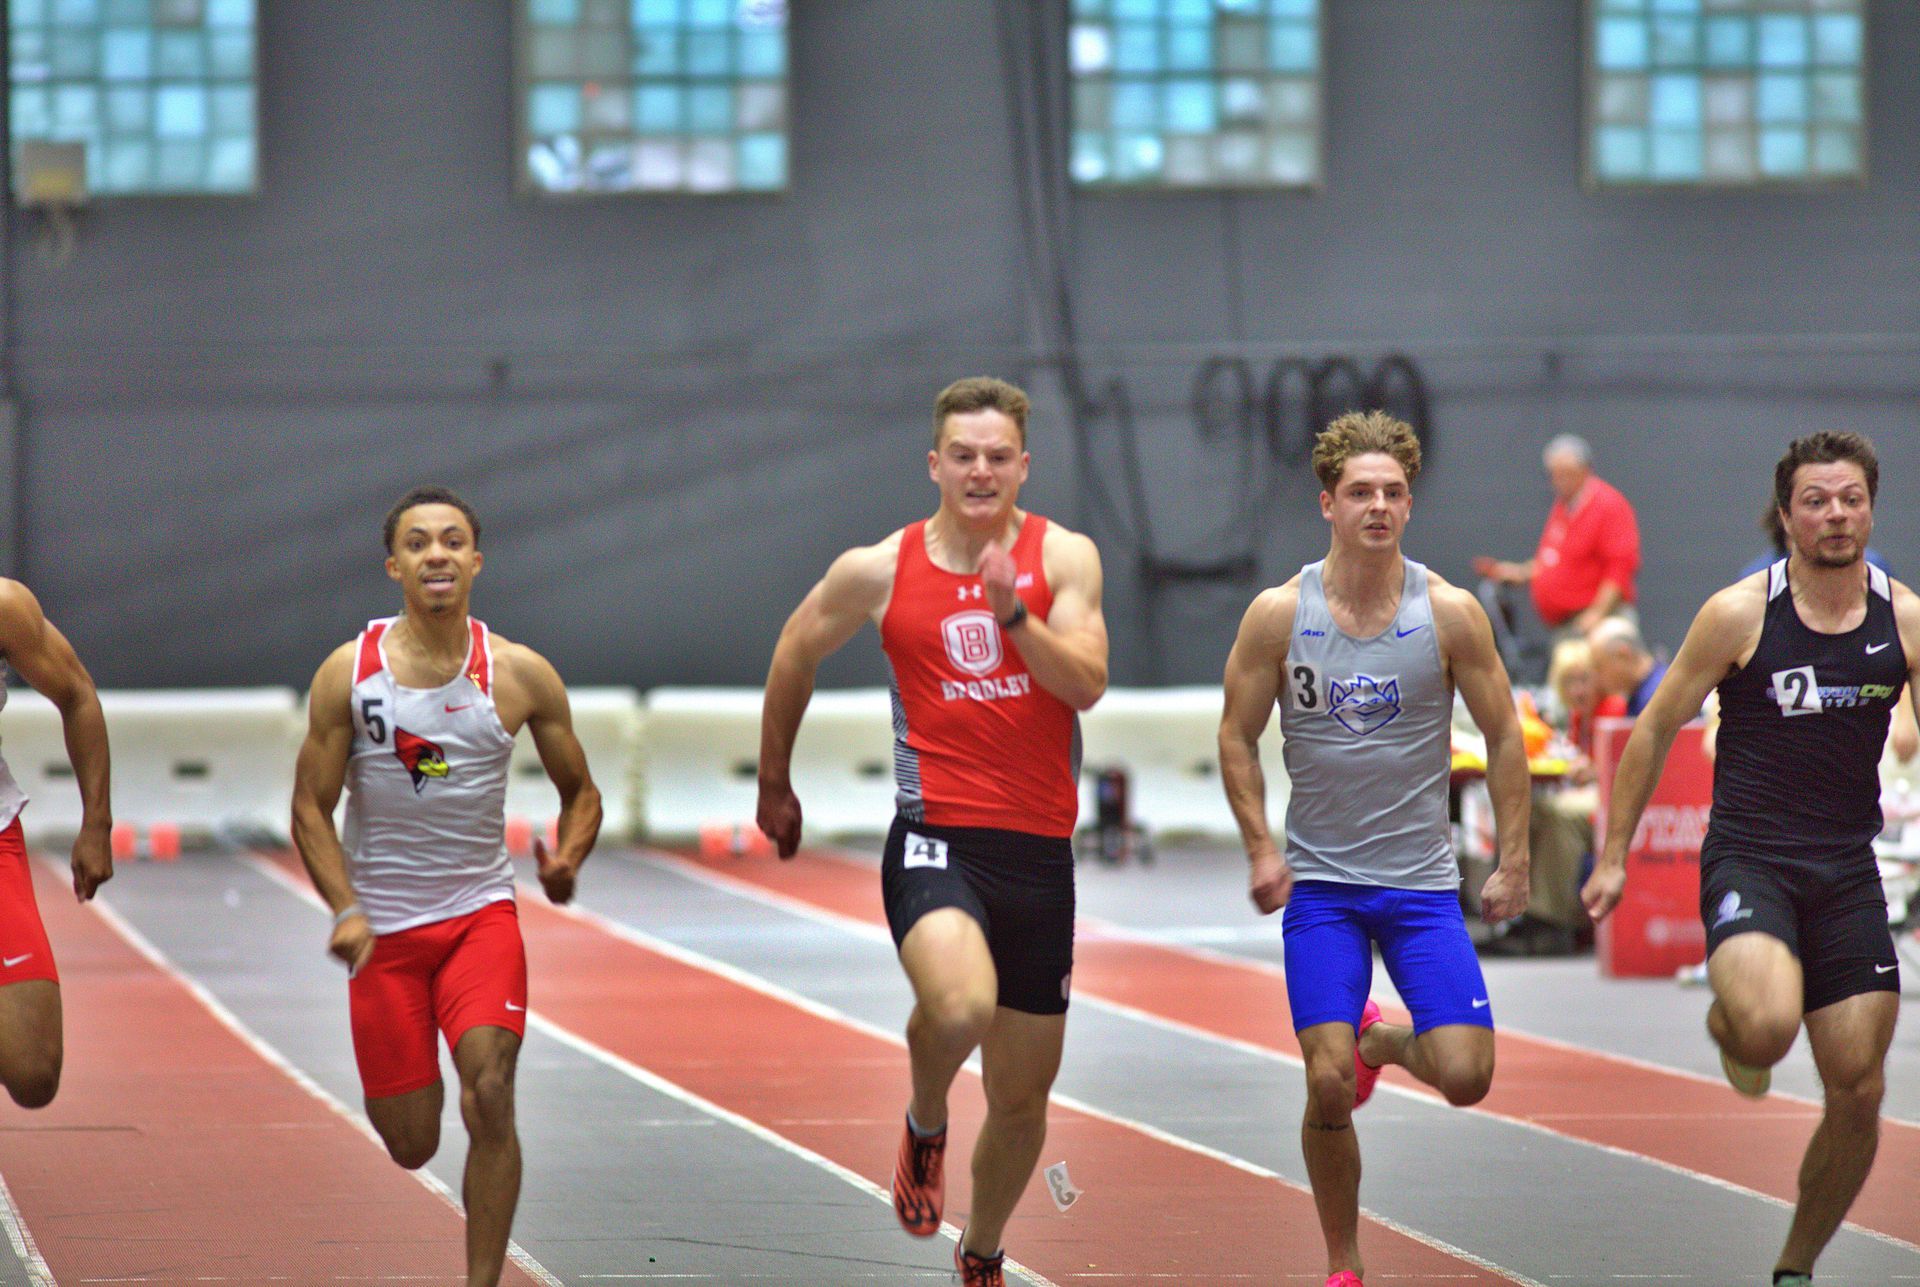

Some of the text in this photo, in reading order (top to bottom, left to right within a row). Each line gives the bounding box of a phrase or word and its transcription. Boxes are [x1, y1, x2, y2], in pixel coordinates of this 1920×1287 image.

[957, 623, 990, 662] B
[1295, 666, 1318, 709] 3
[1784, 671, 1815, 711] 2
[362, 699, 386, 744] 5
[913, 840, 940, 861] 4
[1049, 1168, 1076, 1206] 3
